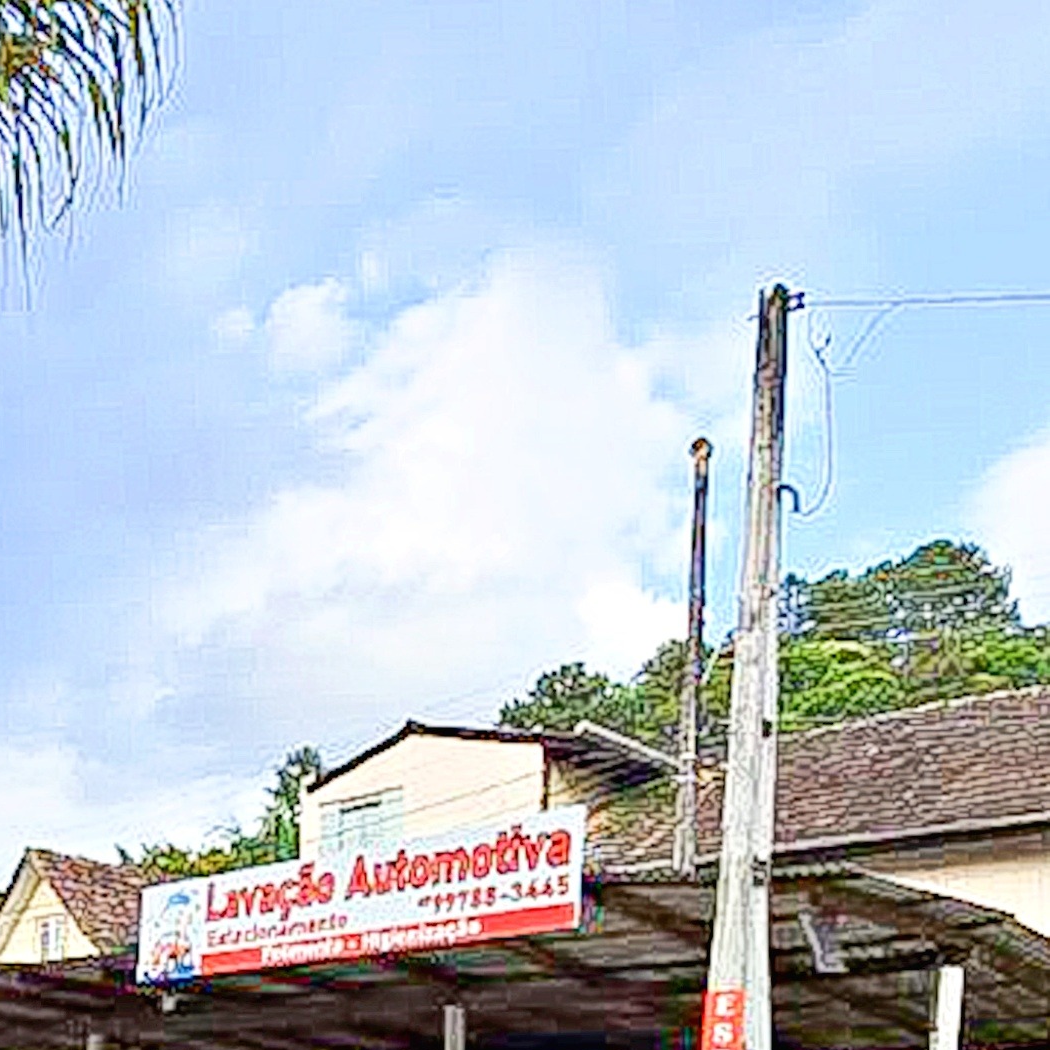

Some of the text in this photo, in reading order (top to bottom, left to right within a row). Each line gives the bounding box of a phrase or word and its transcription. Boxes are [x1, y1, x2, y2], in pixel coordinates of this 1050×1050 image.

[206, 824, 572, 922] Lavação Automotiva
[207, 913, 348, 947] Estacionamento
